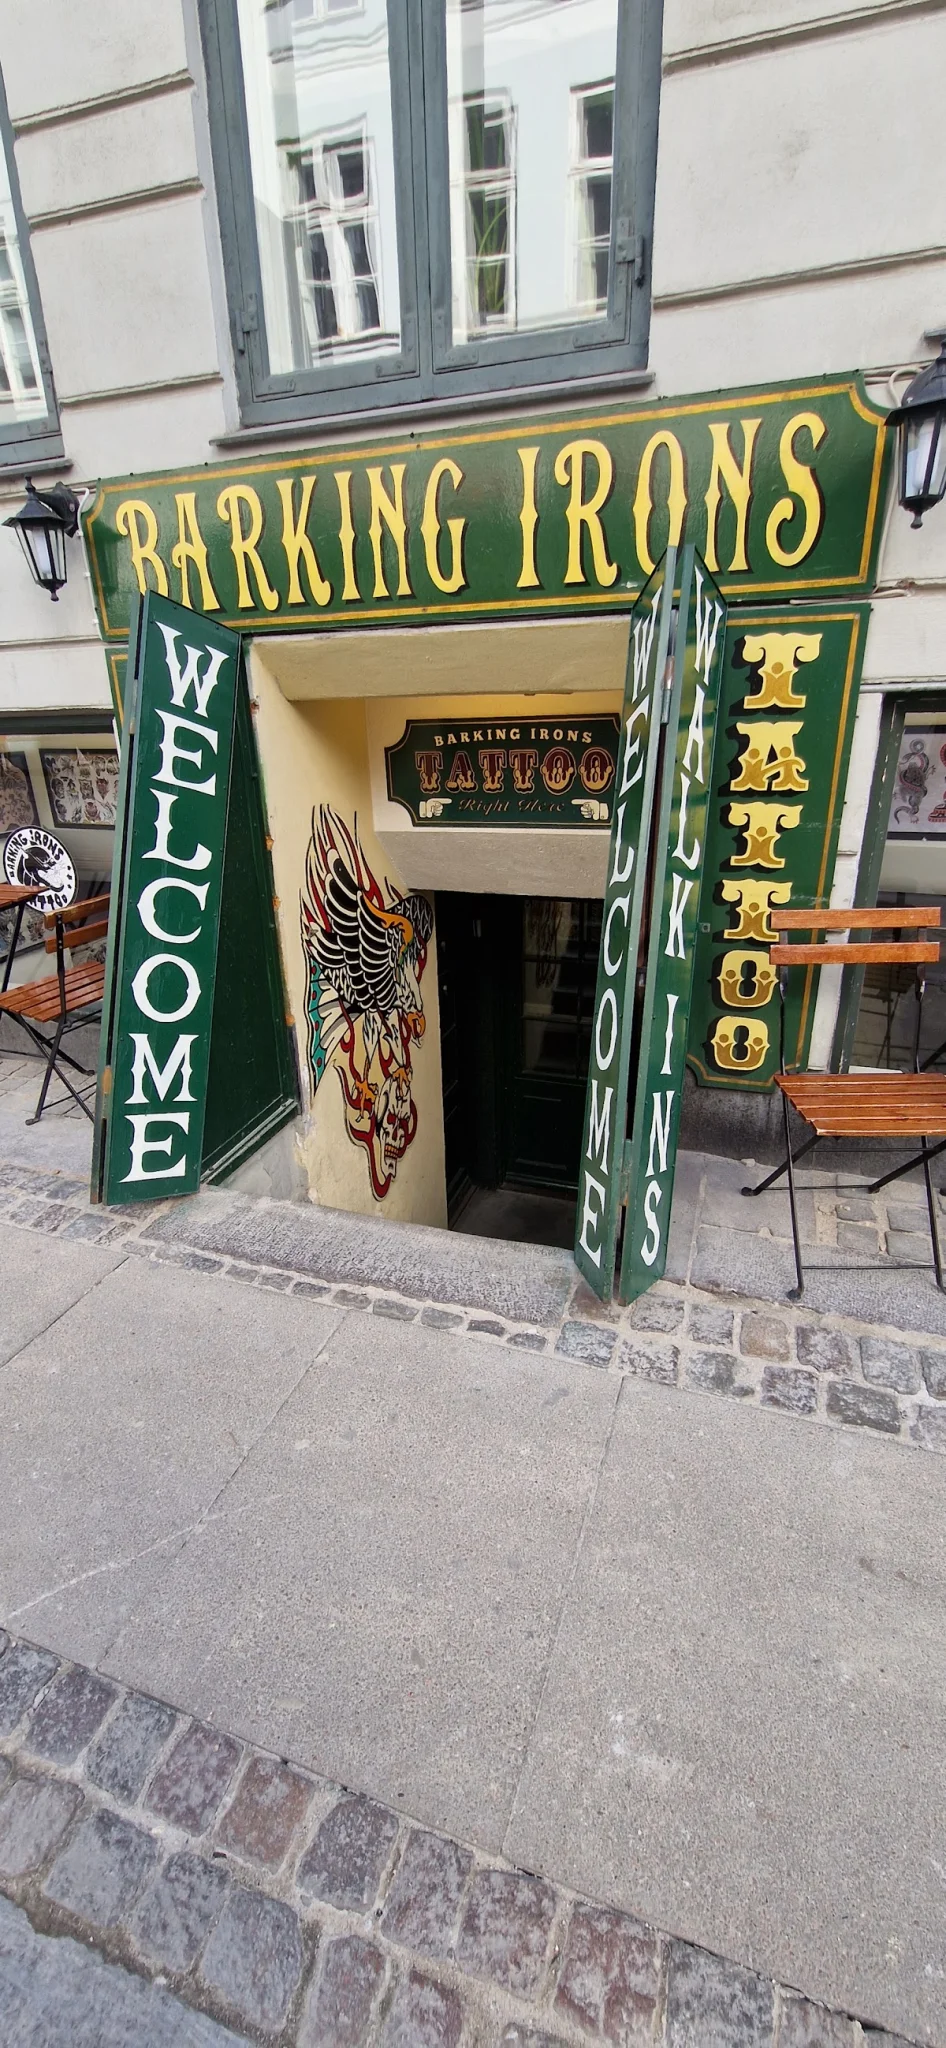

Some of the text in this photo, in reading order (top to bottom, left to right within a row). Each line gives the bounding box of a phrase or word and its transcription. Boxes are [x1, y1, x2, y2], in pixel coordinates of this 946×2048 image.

[116, 412, 827, 611] BARKING IRONS
[415, 747, 615, 795] TATTOO
[434, 728, 593, 747] BARKING IRONS
[458, 798, 565, 816] Right Here
[710, 632, 823, 1071] TATTOO
[118, 621, 229, 1183] WELCOME
[578, 585, 663, 1269] WELCOME
[640, 565, 723, 1267] WALK INS
